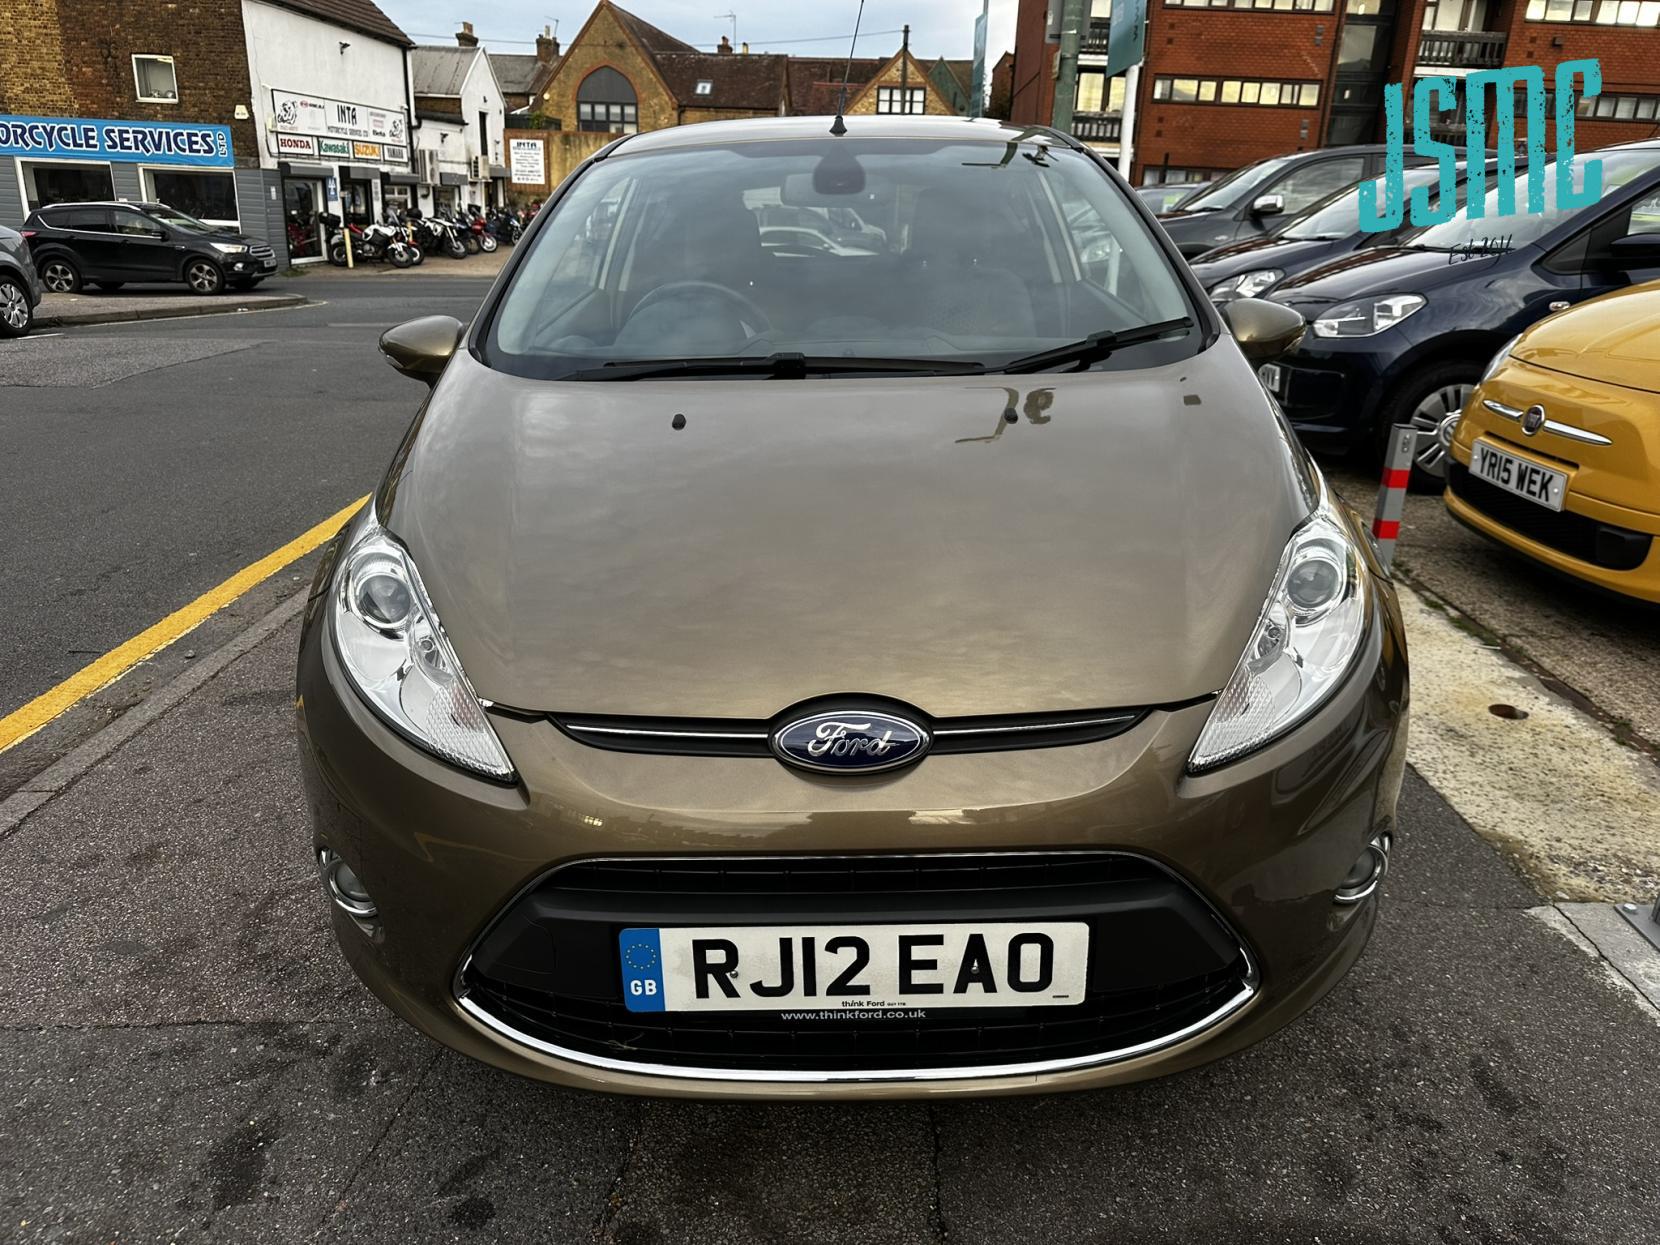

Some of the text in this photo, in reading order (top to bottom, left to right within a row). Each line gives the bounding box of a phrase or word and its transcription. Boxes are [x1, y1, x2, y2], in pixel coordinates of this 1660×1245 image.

[336, 104, 358, 126] INTA
[105, 127, 215, 157] SERVICES
[217, 132, 227, 156] LTD
[280, 138, 312, 149] HONDA
[320, 140, 350, 154] Kawasaki
[354, 143, 381, 157] SUZUKI
[1479, 447, 1553, 502] YR15 WEK
[807, 721, 898, 757] Ford
[691, 932, 1054, 999] RJ12 EAO
[630, 979, 657, 996] GB
[841, 999, 865, 1007] think
[781, 1009, 926, 1020] www.thinkford.co.uk
